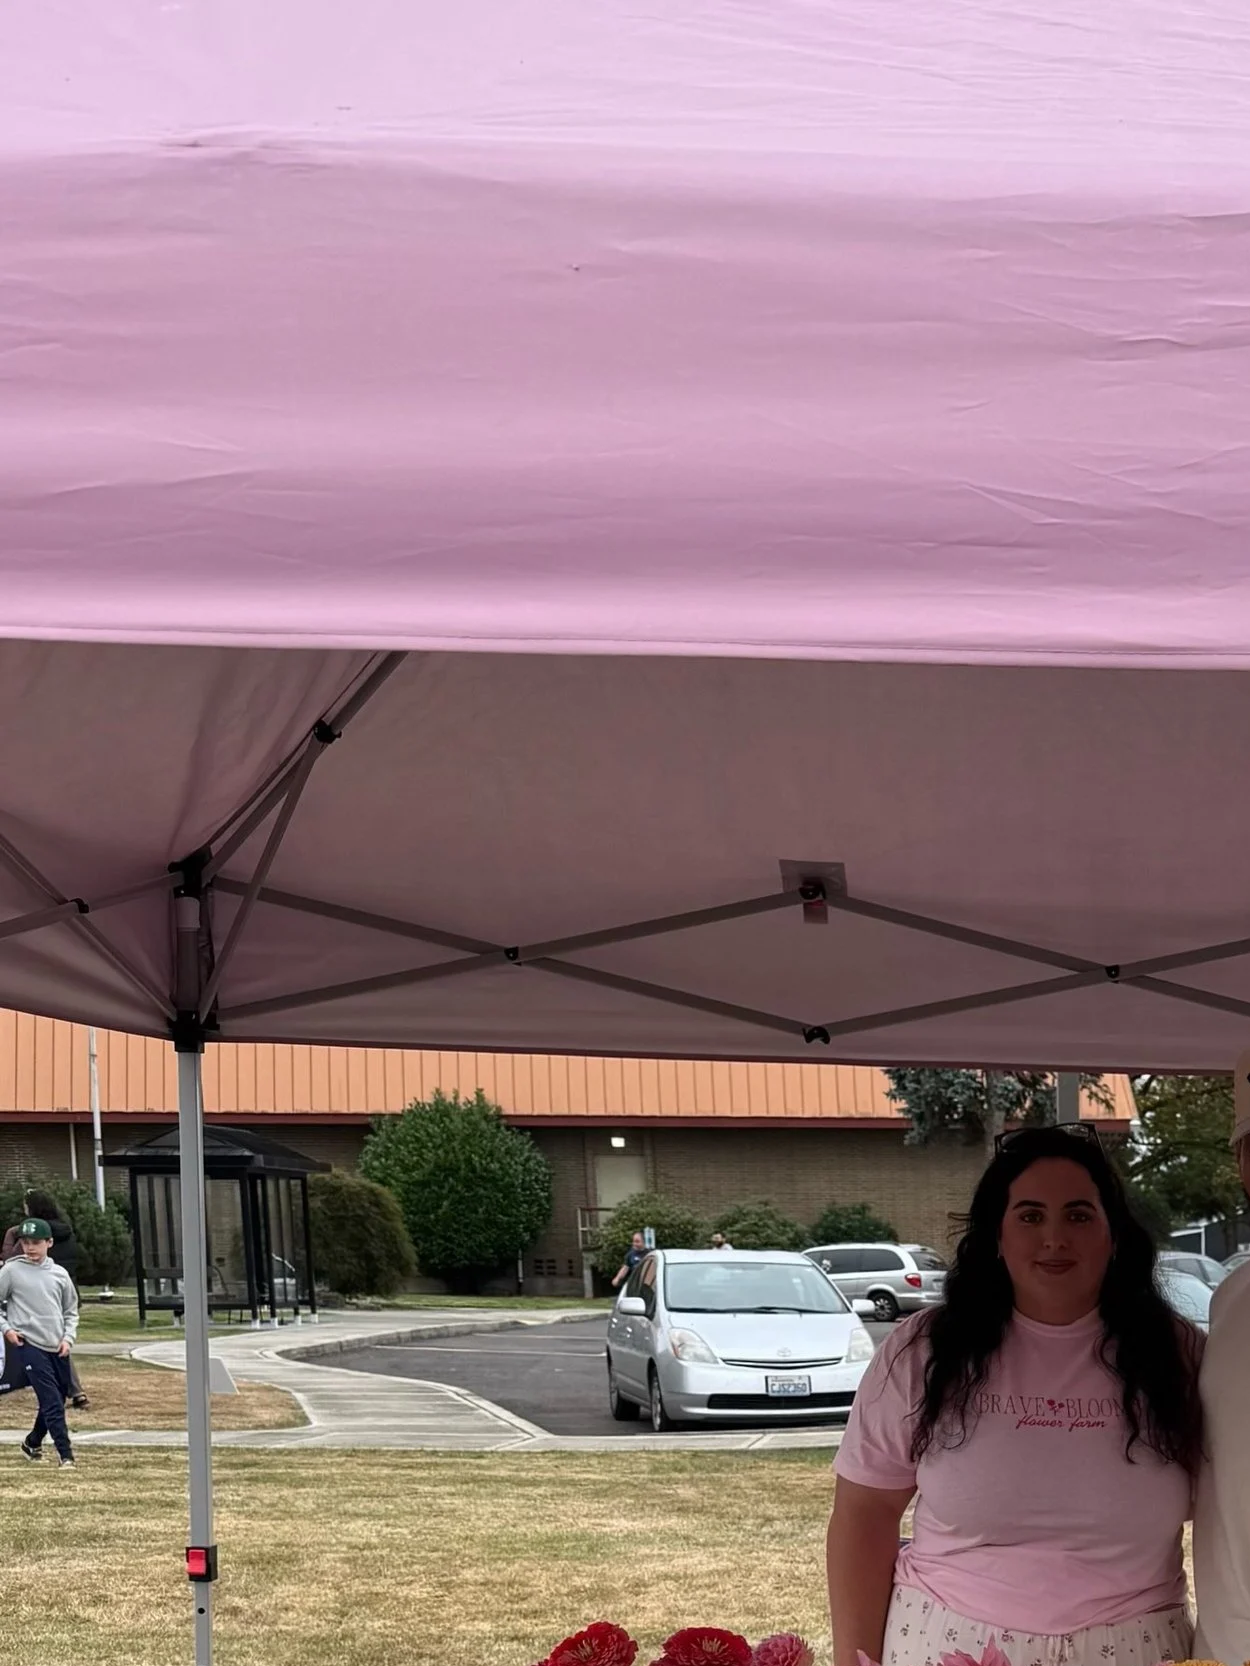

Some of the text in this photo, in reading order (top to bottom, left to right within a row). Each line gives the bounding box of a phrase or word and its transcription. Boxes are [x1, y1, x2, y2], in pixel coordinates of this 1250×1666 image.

[979, 1392, 1045, 1417] BRAVE
[1016, 1414, 1107, 1433] flower farm
